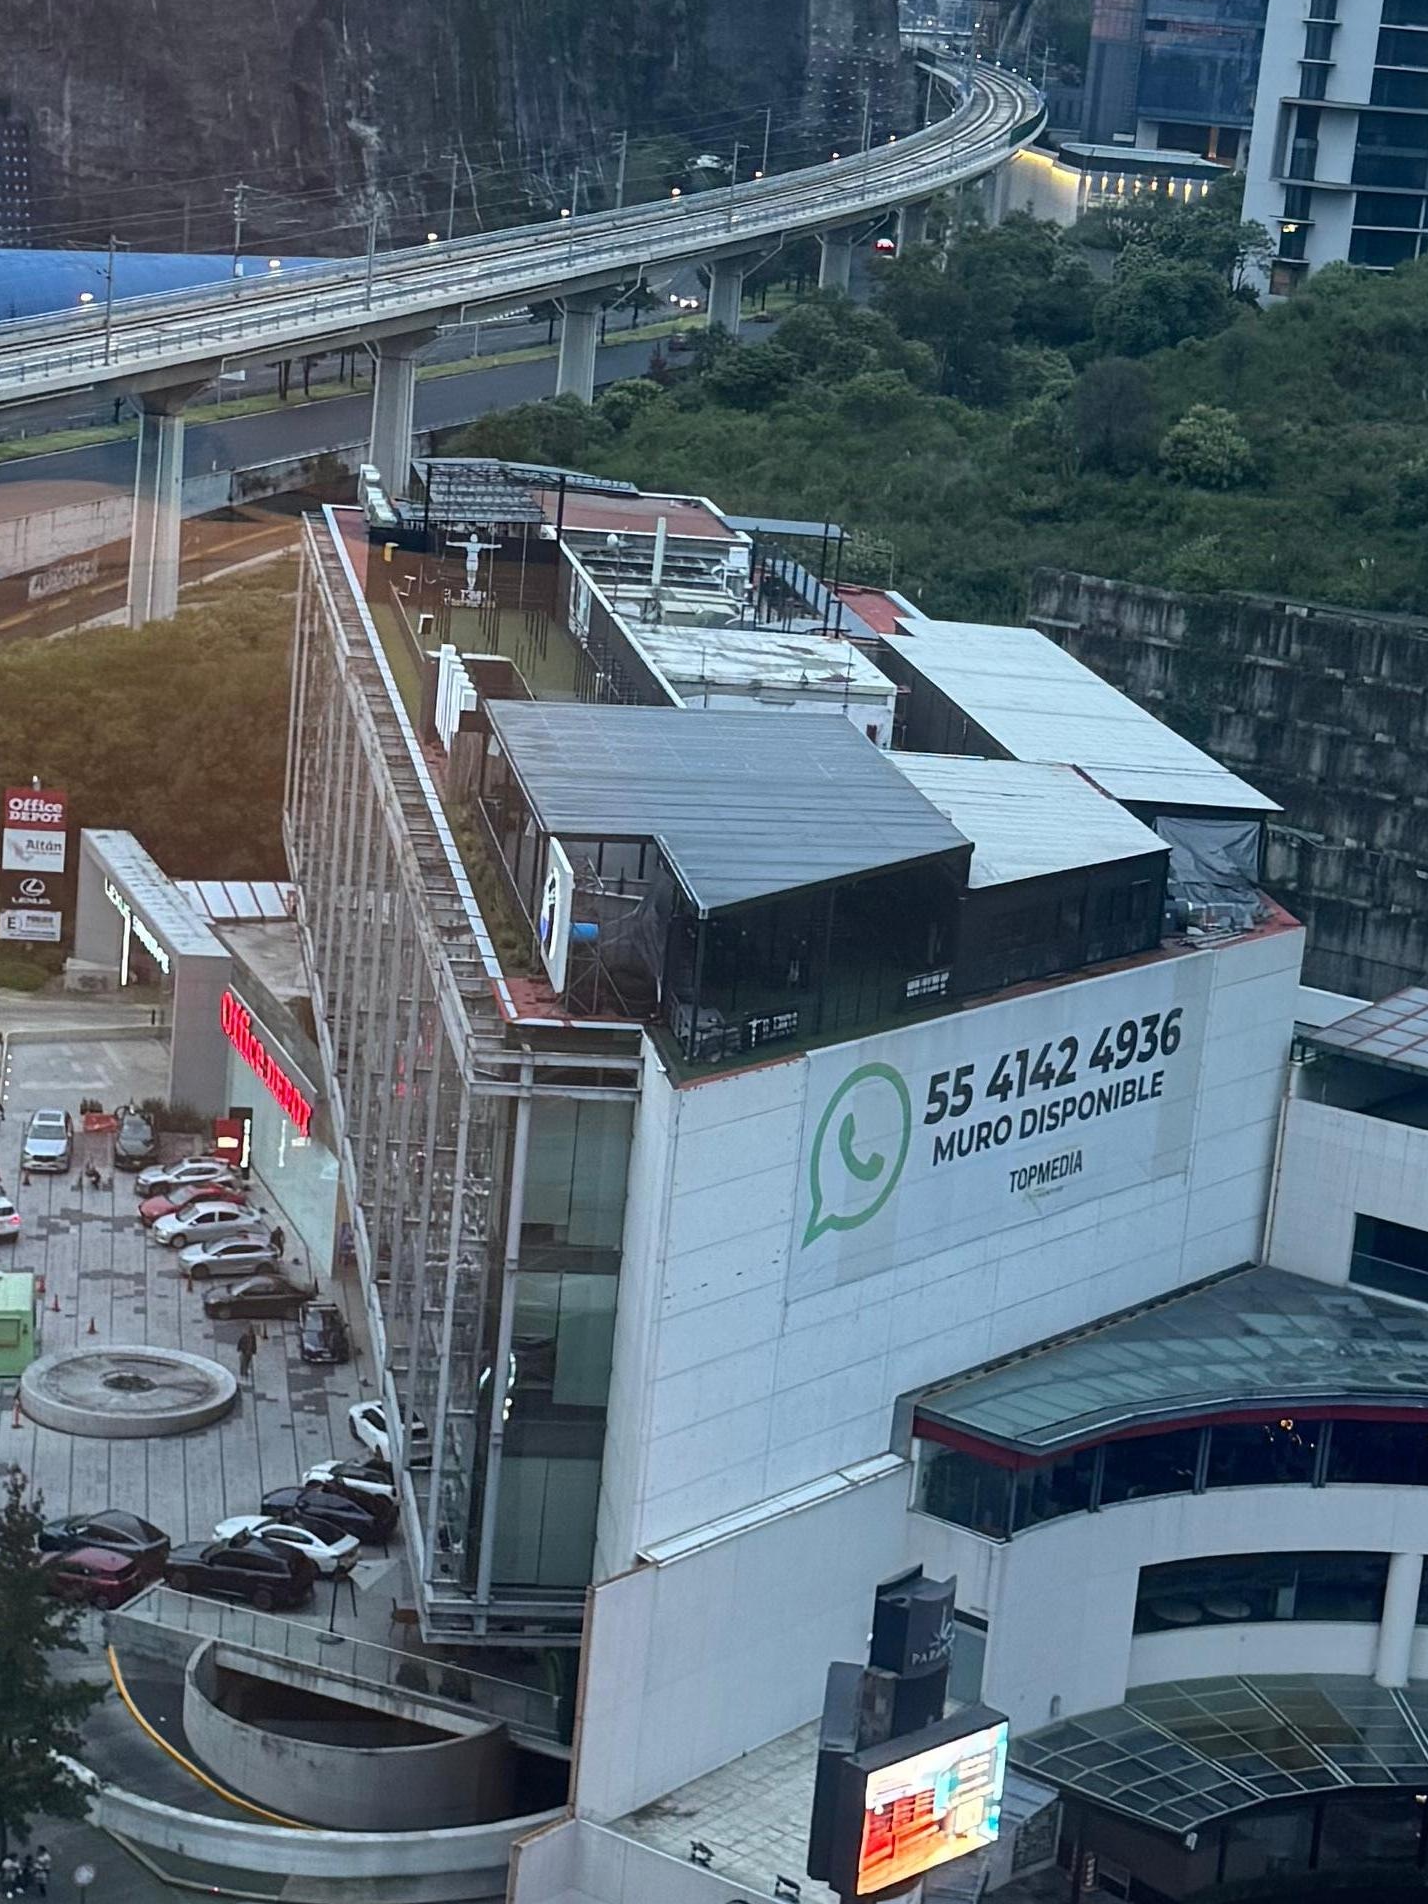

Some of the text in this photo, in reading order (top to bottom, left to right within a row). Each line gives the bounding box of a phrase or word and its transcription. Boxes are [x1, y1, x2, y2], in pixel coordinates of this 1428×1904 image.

[9, 798, 63, 813] Office
[9, 811, 63, 823] DEPOT
[924, 1007, 1185, 1125] 55 4142 4936
[932, 1070, 1166, 1167] MURO DISPONIBLE
[1009, 1149, 1084, 1194] TOPMEDIA
